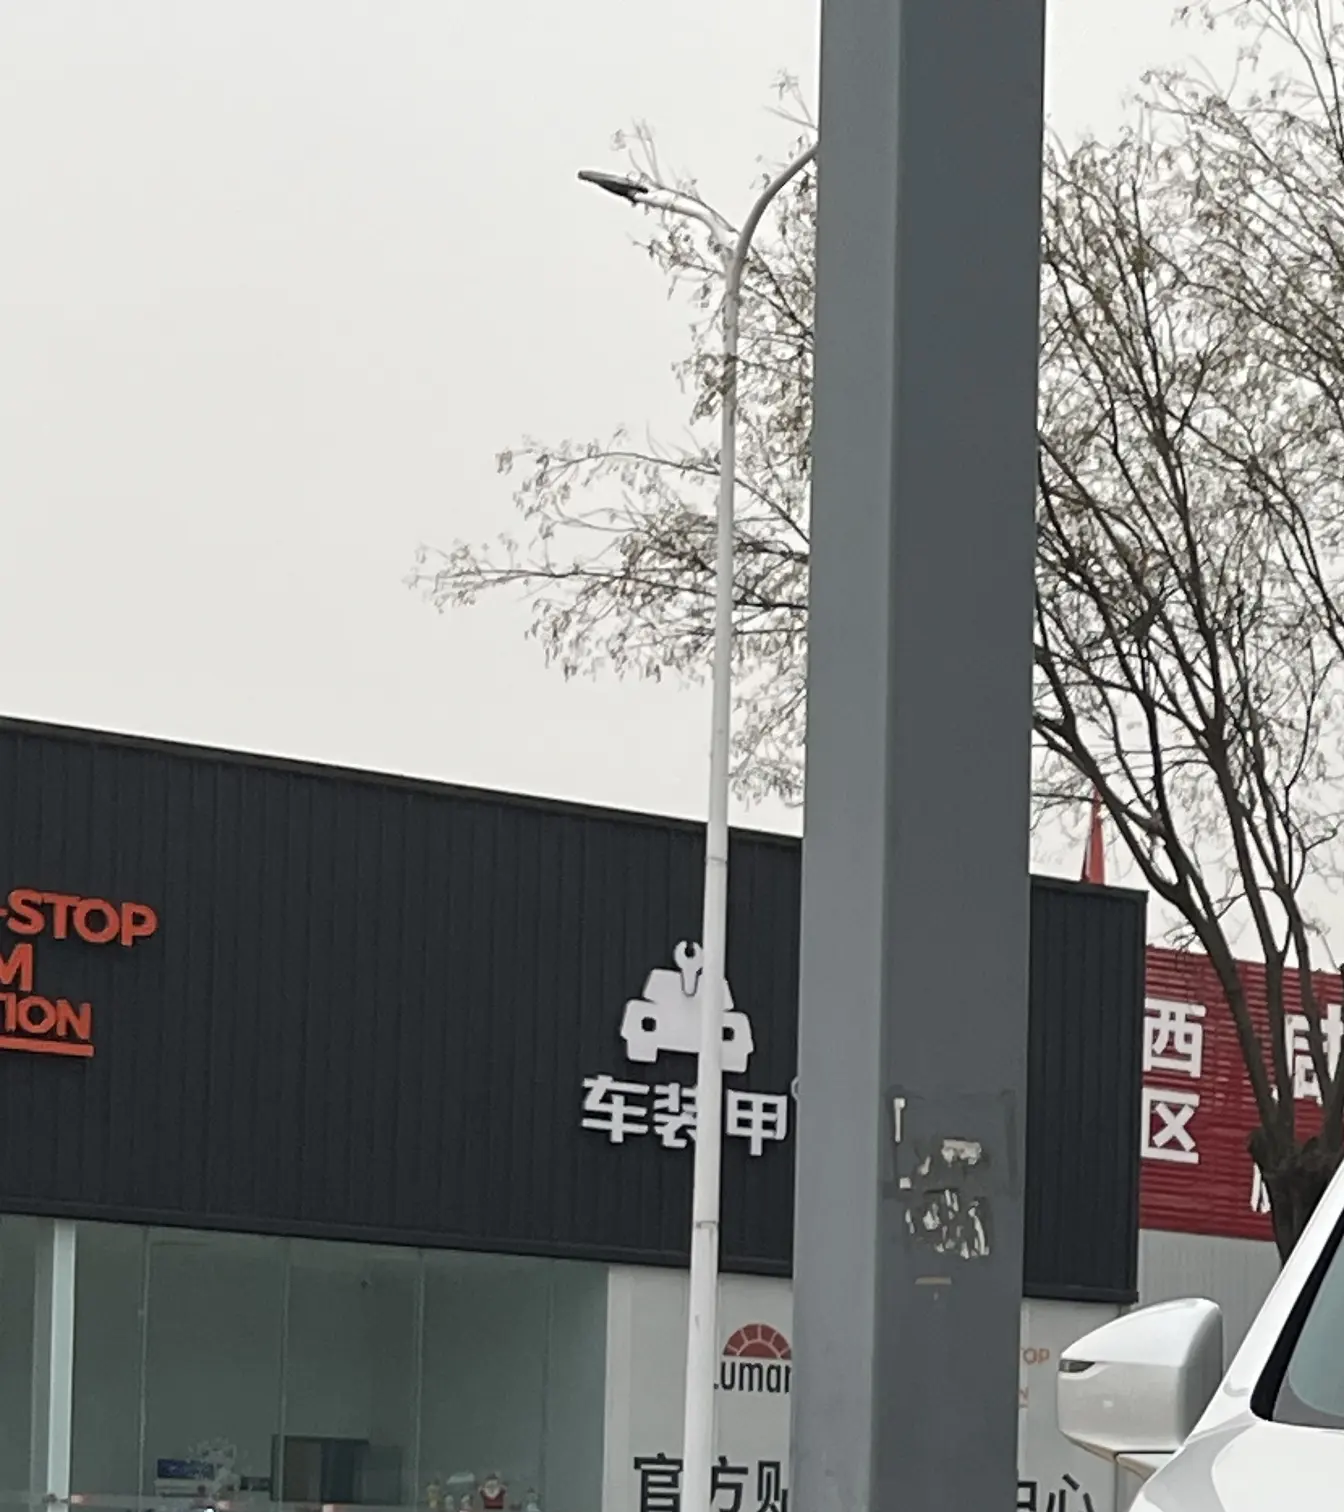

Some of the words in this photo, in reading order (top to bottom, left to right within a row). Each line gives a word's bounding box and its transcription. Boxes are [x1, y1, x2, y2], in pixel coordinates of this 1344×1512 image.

[581, 1075, 788, 1157] 车装甲
[713, 1361, 792, 1394] umar
